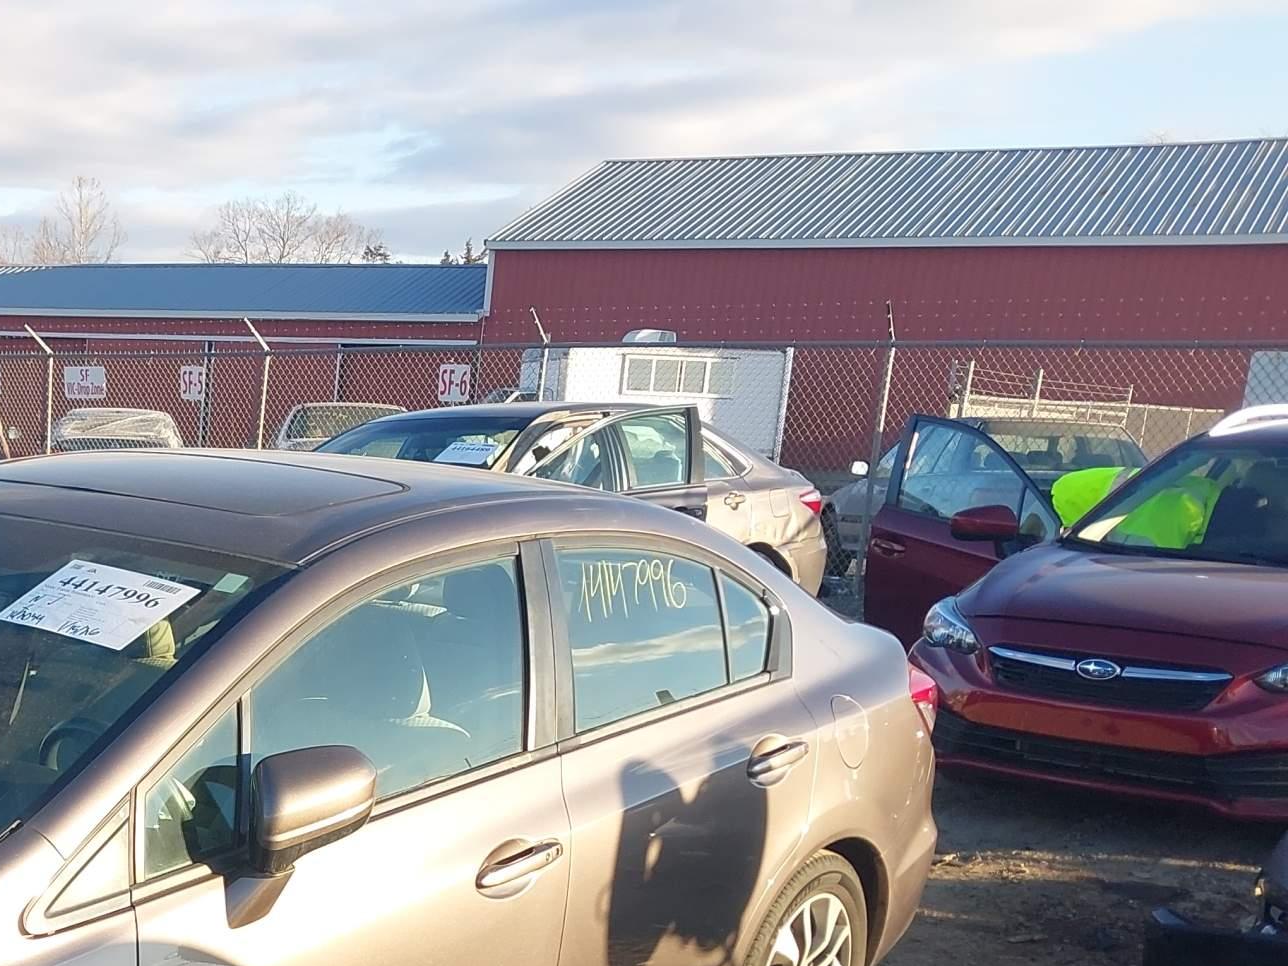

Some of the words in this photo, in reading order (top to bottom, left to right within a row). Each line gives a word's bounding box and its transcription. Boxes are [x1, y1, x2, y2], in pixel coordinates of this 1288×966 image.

[79, 368, 90, 382] SF
[182, 370, 202, 395] SF-5
[439, 369, 467, 396] SF-6
[59, 575, 164, 609] 44147996
